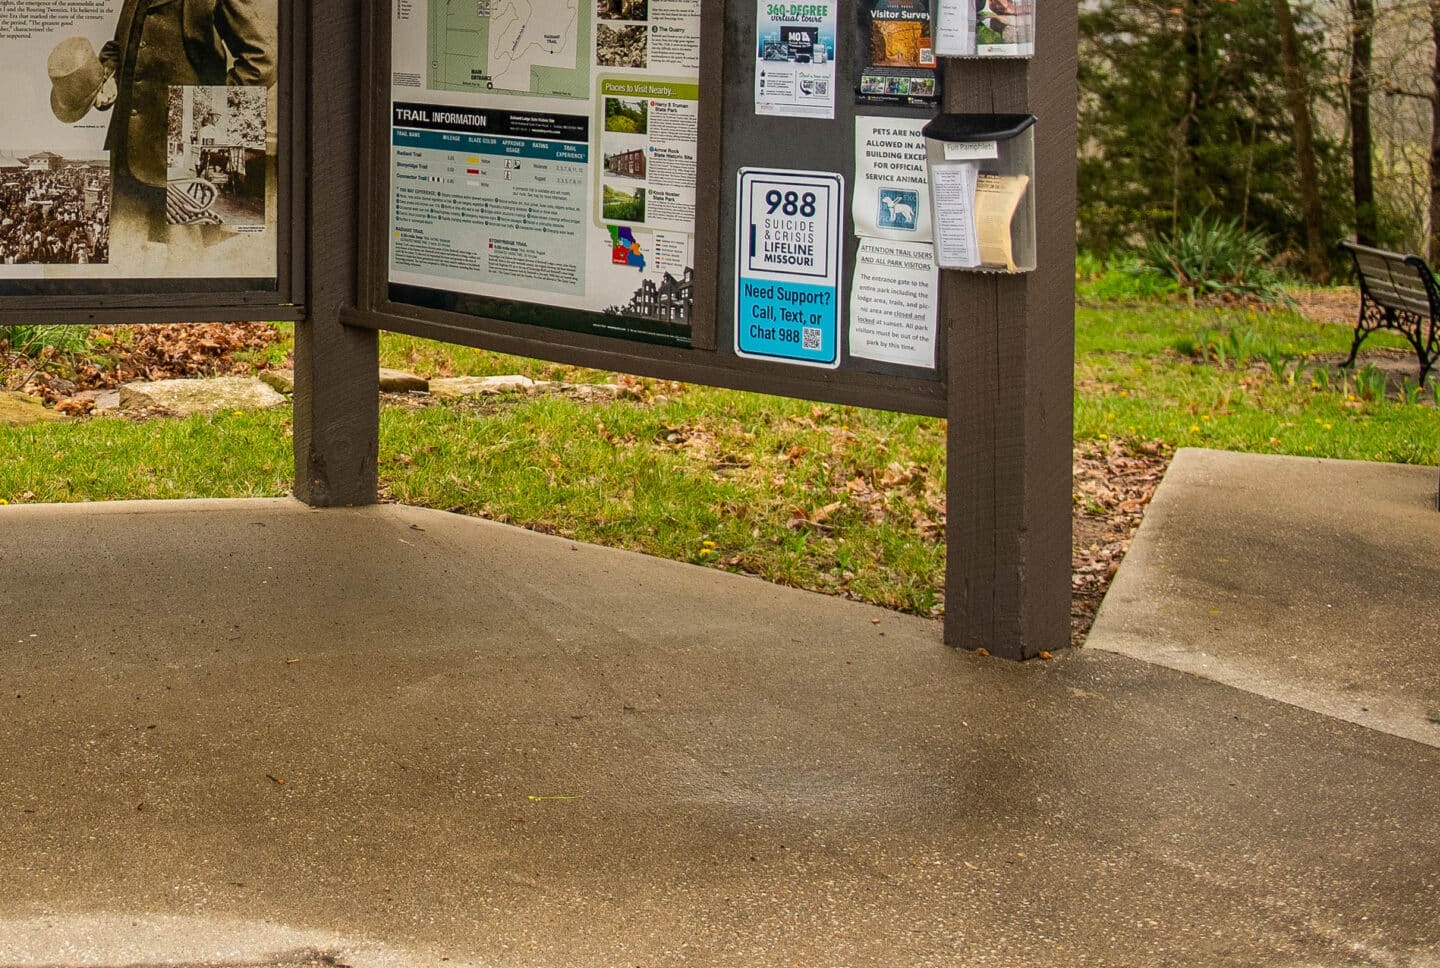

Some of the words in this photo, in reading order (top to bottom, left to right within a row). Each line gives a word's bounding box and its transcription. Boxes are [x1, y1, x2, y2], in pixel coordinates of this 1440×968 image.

[767, 4, 828, 16] 360-DEGREE
[870, 10, 900, 19] Visitor
[901, 10, 930, 21] Survey
[771, 12, 799, 22] virtual
[605, 83, 626, 92] Places
[626, 84, 634, 92] to
[634, 85, 648, 93] Visit
[396, 108, 430, 123] TRAIL
[432, 111, 487, 127] INFORMATION
[872, 128, 891, 136] PETS
[892, 129, 907, 137] ARE
[866, 139, 903, 149] ALLOWED
[915, 142, 926, 150] AN
[866, 150, 902, 159] BUILDING
[904, 153, 928, 161] EXCEP
[890, 163, 923, 172] OFFICIAL
[865, 172, 895, 182] SERVICE
[896, 175, 928, 184] ANIMAL
[765, 189, 816, 217] 988
[765, 218, 815, 232] SUICIDE
[764, 230, 771, 240] &
[774, 230, 814, 244] CRISIS
[764, 241, 814, 256] LIFELINE
[861, 245, 894, 254] ATTENTION
[896, 248, 911, 256] TRAIL
[913, 250, 933, 259] USERS
[764, 252, 813, 267] MISSOURI
[861, 256, 874, 264] AND
[887, 259, 903, 267] PARK
[904, 261, 931, 270] VISITORS
[861, 273, 871, 281] The
[872, 275, 897, 284] entrance
[744, 283, 774, 300] Need
[777, 286, 831, 306] Support?
[877, 286, 889, 294] park
[891, 288, 917, 298] including
[918, 291, 928, 299] the
[857, 295, 872, 303] lodge
[889, 299, 905, 307] trails,
[752, 305, 777, 322] Call,
[780, 307, 807, 325] Text,
[809, 313, 822, 325] or
[893, 311, 913, 319] closed
[857, 316, 875, 325] locked
[883, 320, 903, 328] sunset.
[915, 323, 928, 332] park
[750, 325, 776, 341] Chat
[779, 328, 800, 344] 988
[855, 327, 875, 335] visitors
[919, 334, 930, 342] the
[866, 339, 879, 347] park
[880, 340, 887, 349] by
[889, 341, 900, 349] this
[901, 343, 916, 351] time.
